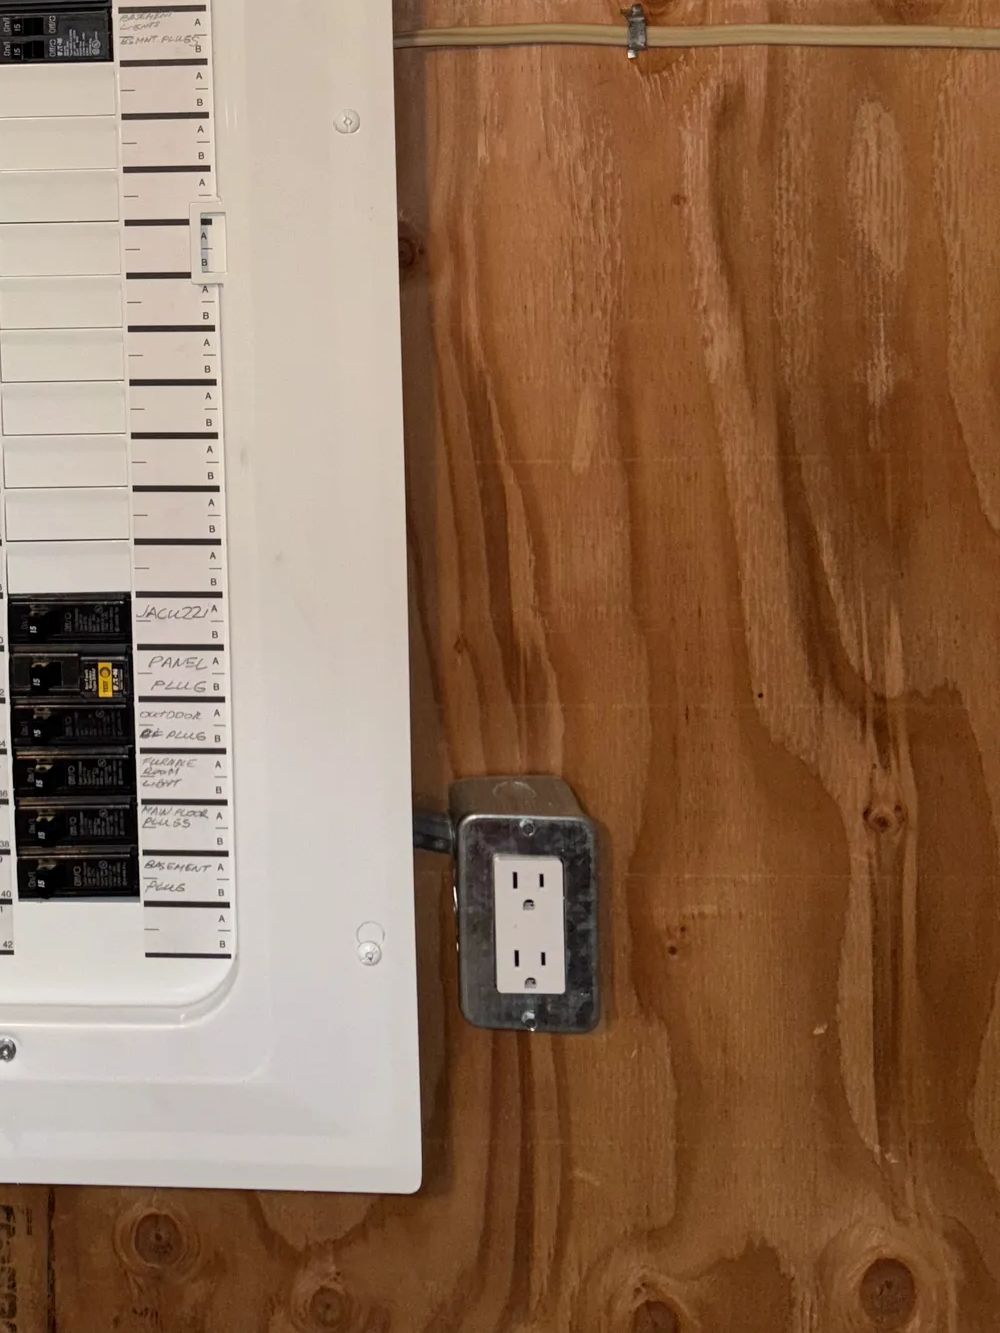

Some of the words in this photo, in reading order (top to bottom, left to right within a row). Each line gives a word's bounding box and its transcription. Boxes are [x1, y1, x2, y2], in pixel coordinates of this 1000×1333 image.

[14, 23, 21, 32] 15
[13, 47, 21, 56] 15
[136, 605, 209, 620] JACUZZI
[148, 655, 208, 670] PANEL
[150, 680, 207, 693] PLUG
[165, 730, 206, 741] PLUG
[142, 817, 191, 828] PLUGS
[0, 840, 10, 848] 38
[144, 859, 212, 873] BASEMENT
[0, 889, 12, 898] 40
[218, 914, 226, 923] A
[2, 940, 14, 949] 42
[219, 939, 226, 949] B
